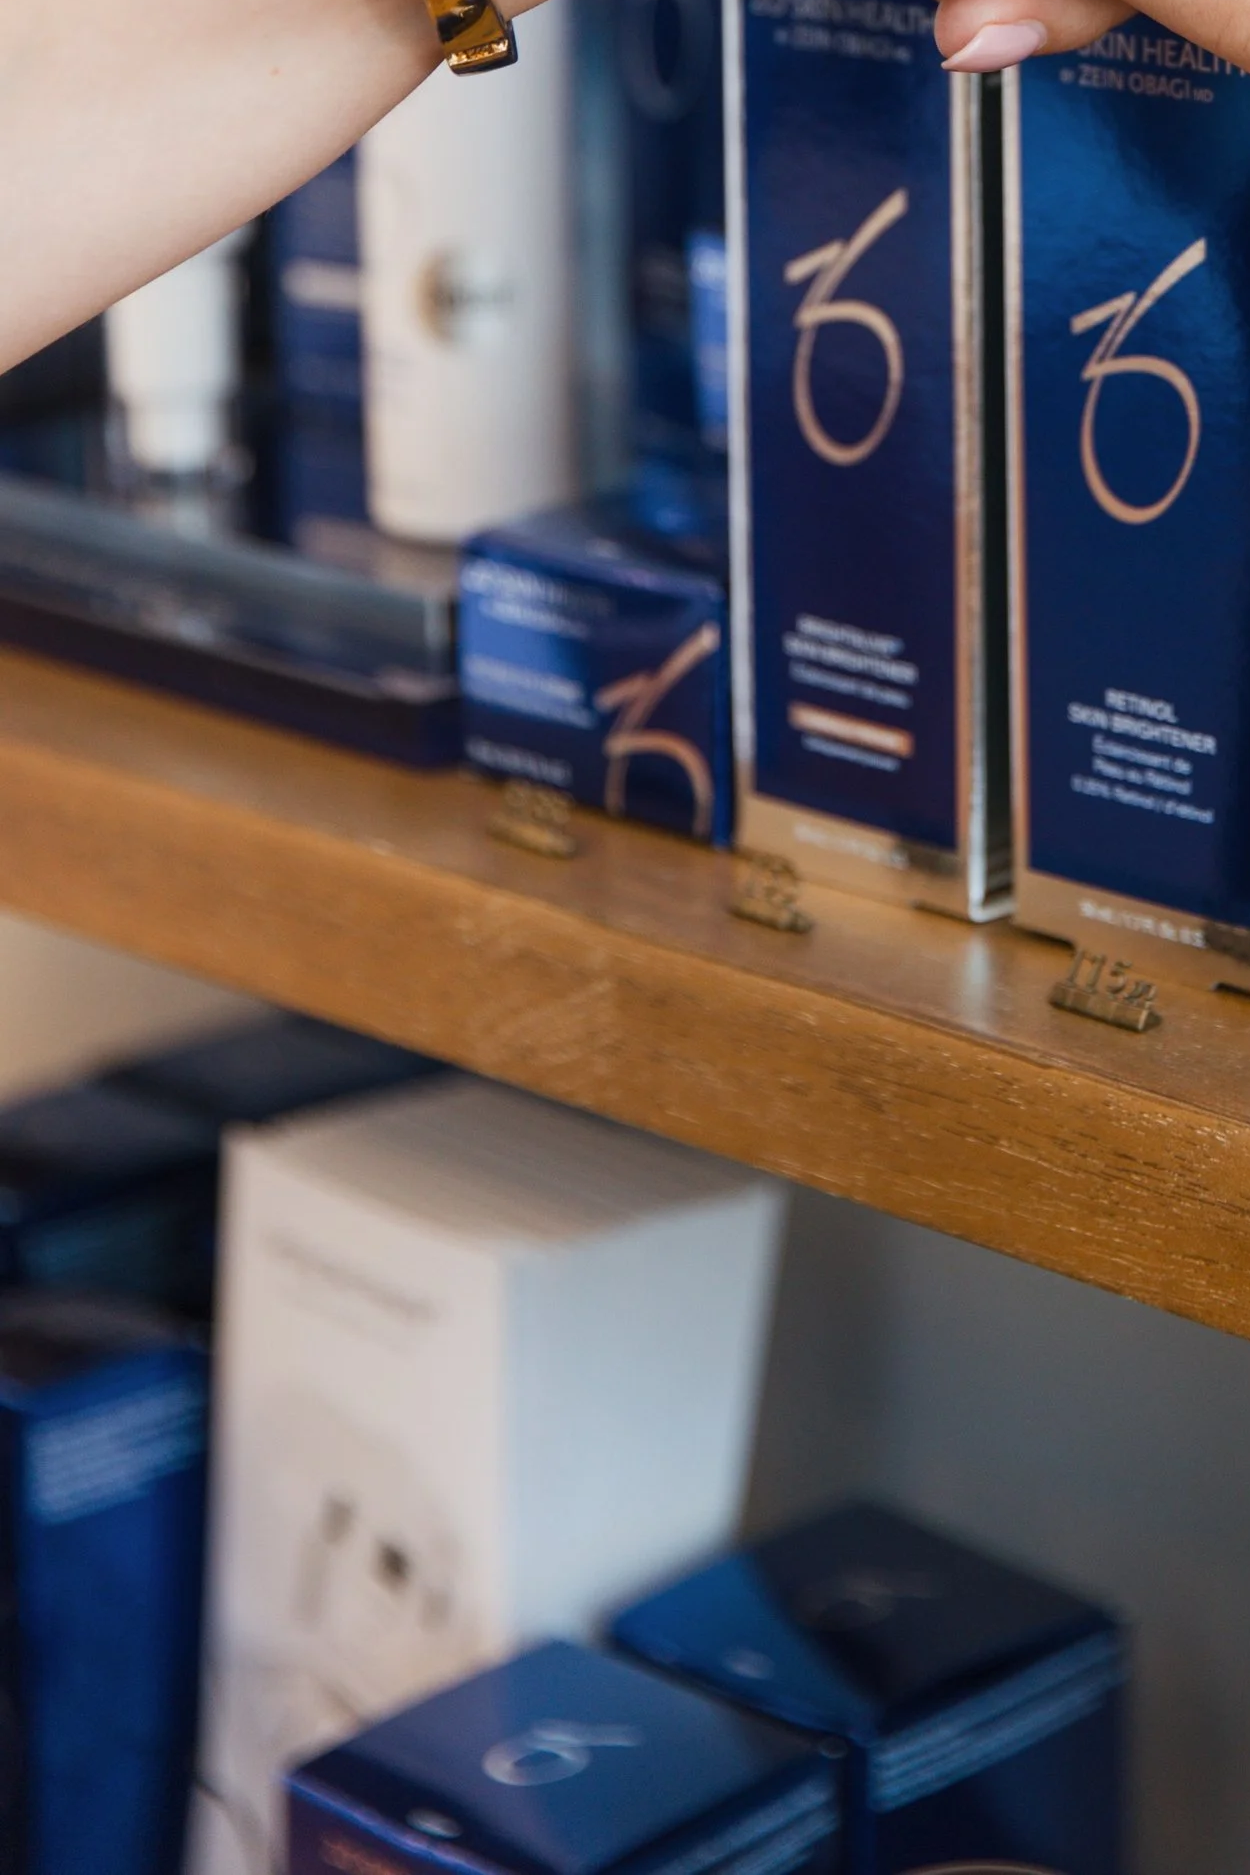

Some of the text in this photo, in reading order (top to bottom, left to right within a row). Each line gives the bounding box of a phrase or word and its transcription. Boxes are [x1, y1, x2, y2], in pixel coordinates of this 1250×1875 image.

[1078, 64, 1125, 91] ZEIN
[1128, 72, 1191, 100] OBAGI
[1104, 687, 1178, 724] RETINOL
[1067, 701, 1218, 756] SKIN BRIGHTENER
